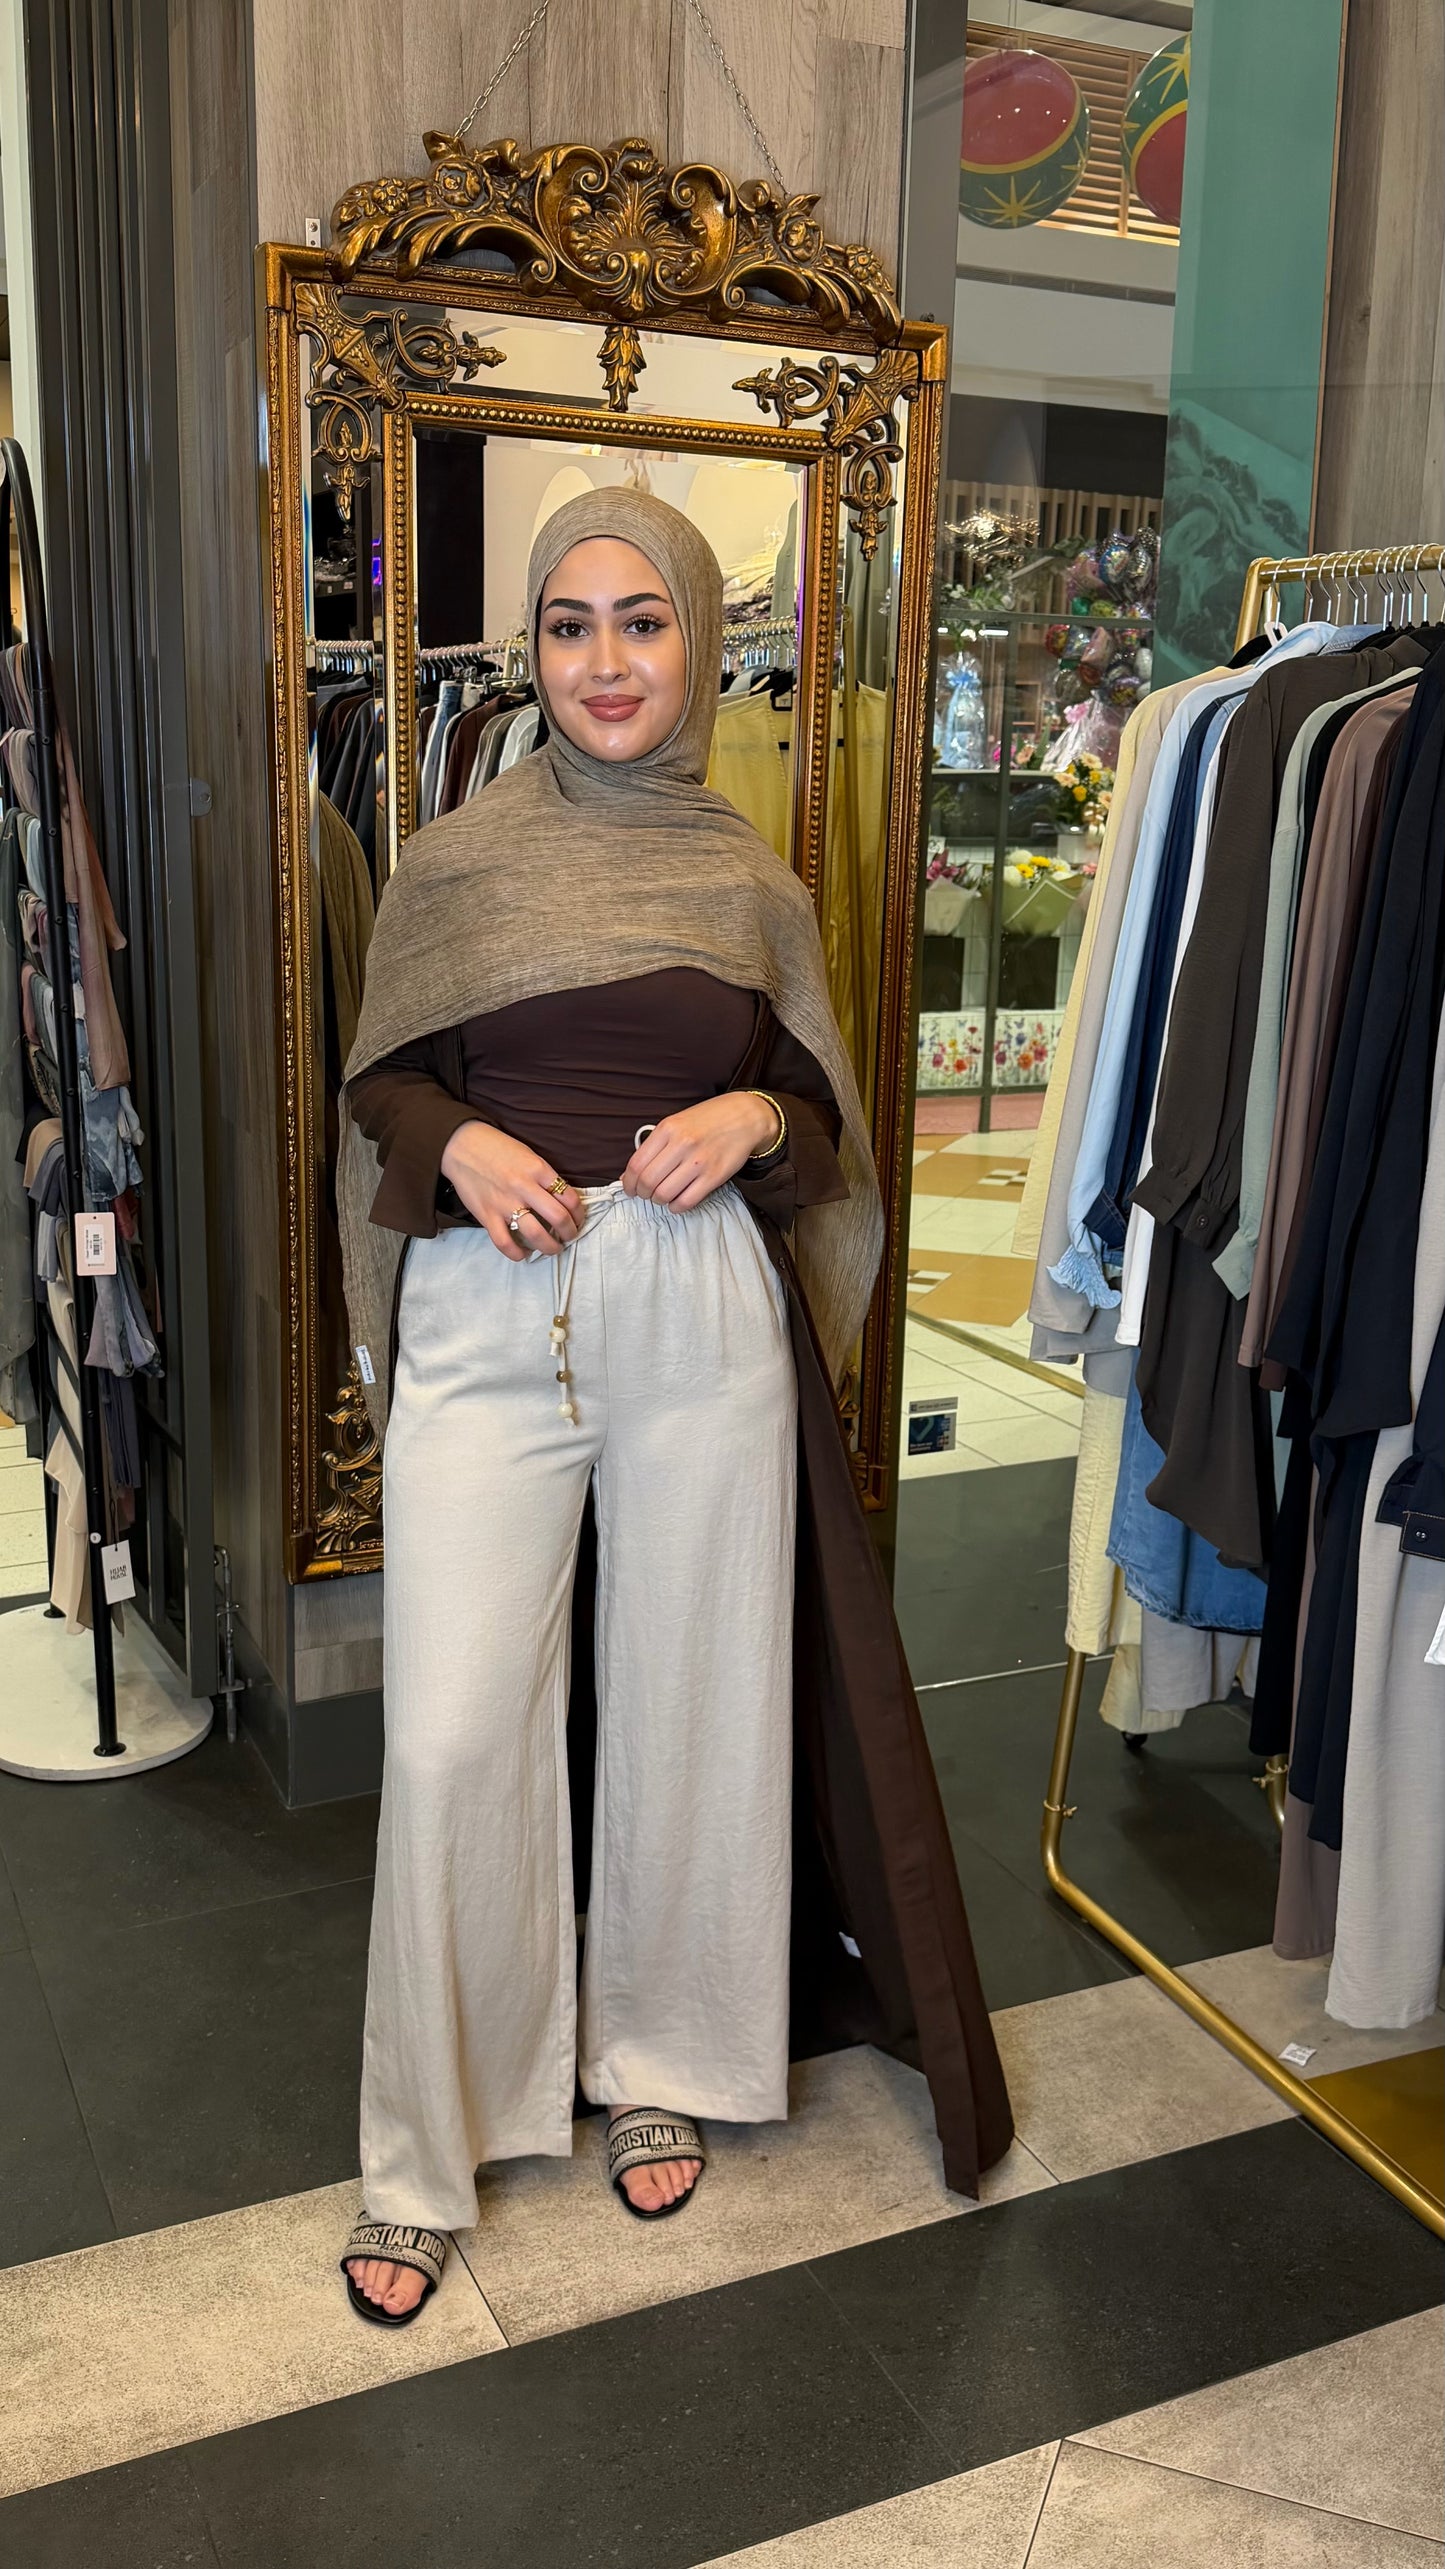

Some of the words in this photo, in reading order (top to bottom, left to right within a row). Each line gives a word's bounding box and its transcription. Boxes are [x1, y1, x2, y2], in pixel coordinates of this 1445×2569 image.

[650, 2145, 672, 2153] PARIS
[350, 2225, 418, 2248] HRISTIAN
[380, 2244, 403, 2253] PARIS
